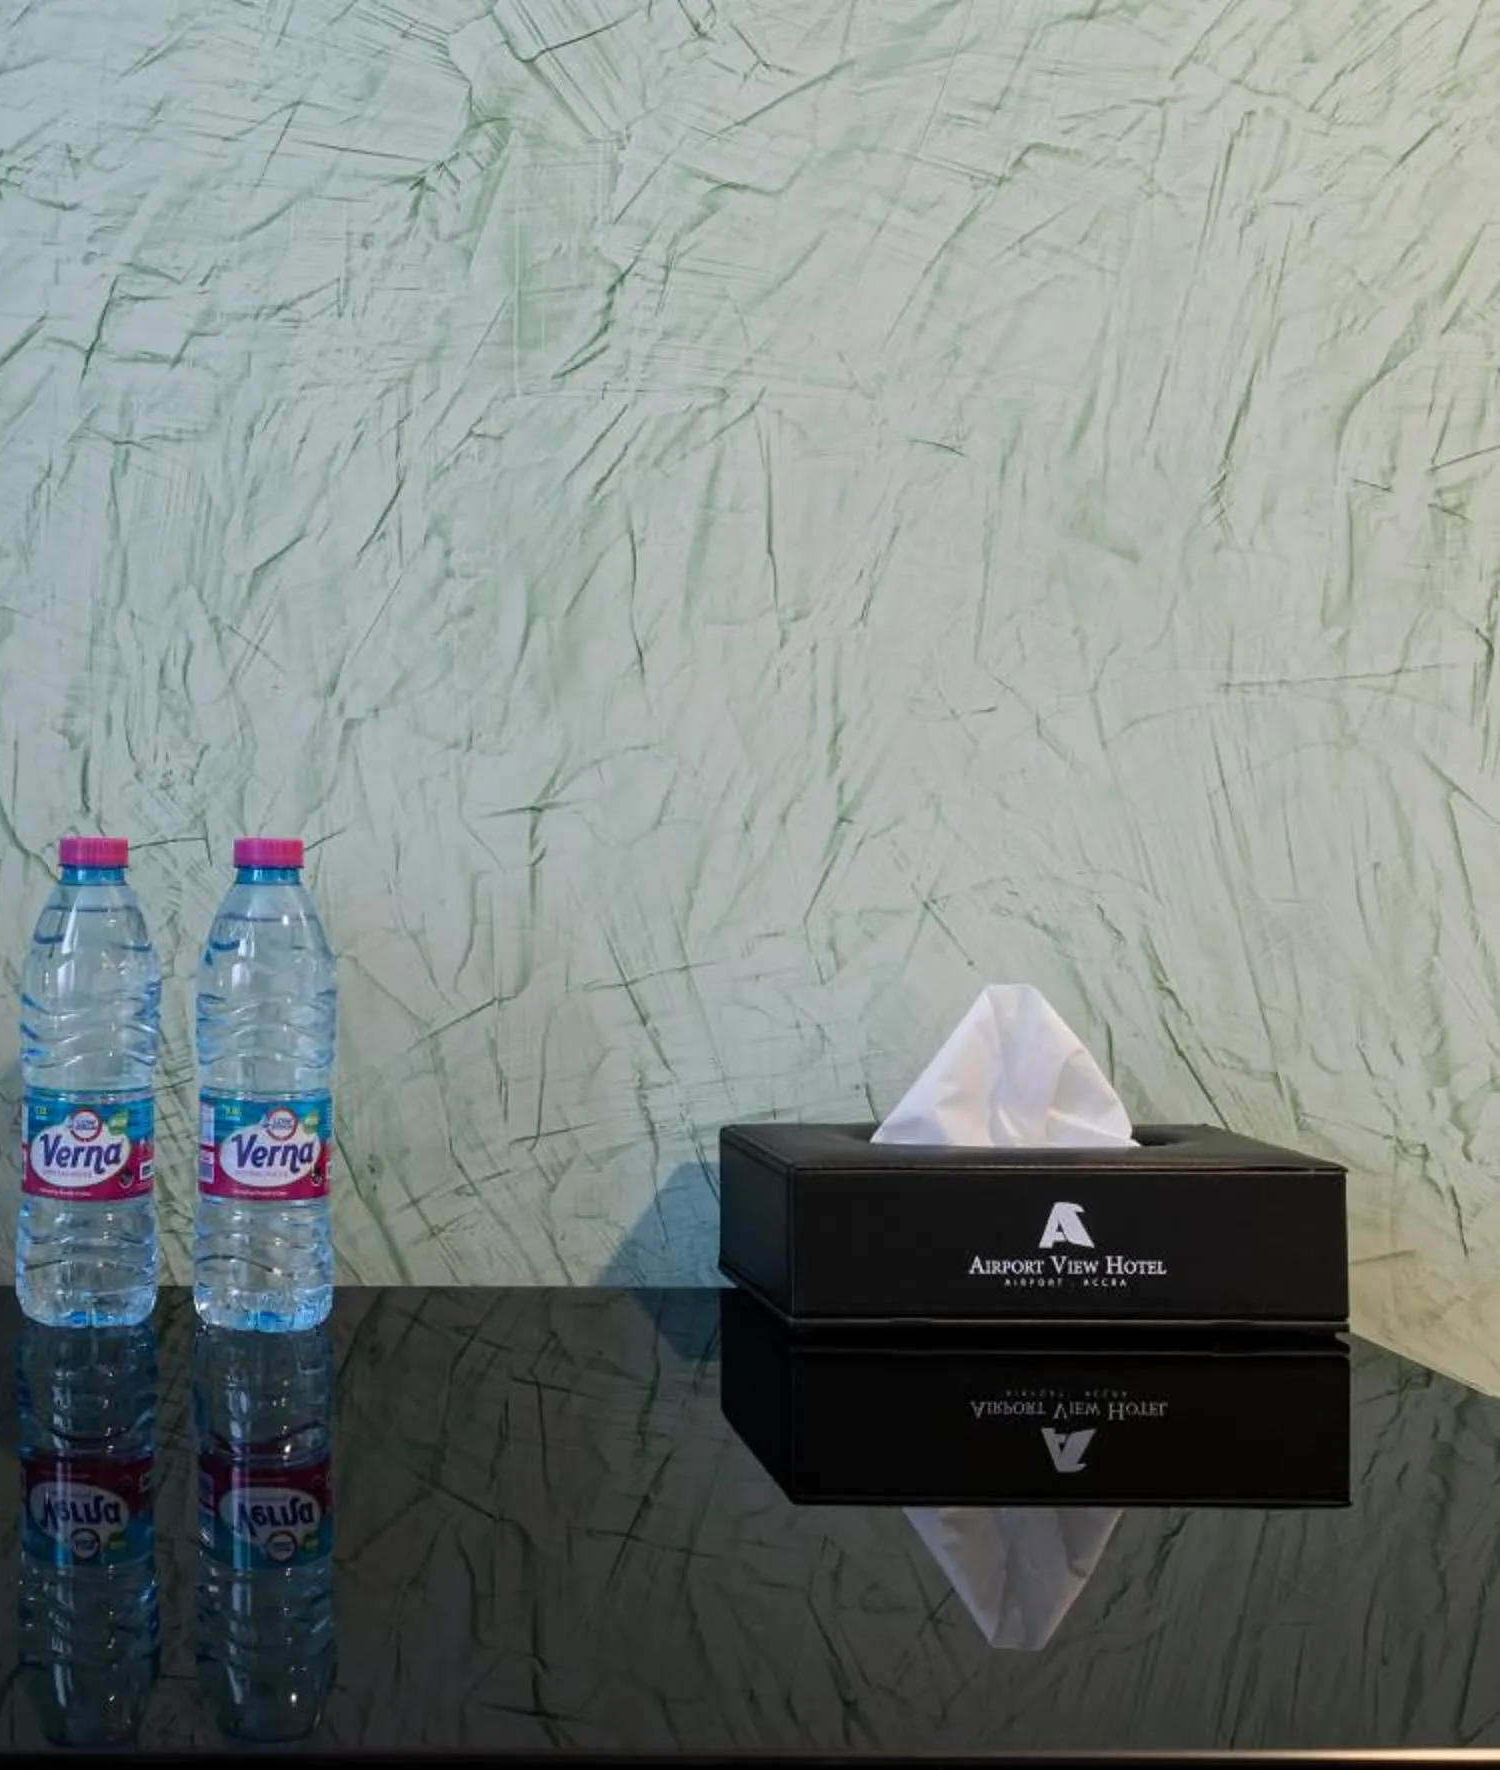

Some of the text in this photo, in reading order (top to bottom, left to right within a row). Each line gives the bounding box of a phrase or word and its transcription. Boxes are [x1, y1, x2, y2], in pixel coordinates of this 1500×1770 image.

[40, 1133, 122, 1175] Verna
[231, 1133, 314, 1174] Verna
[969, 1255, 1167, 1275] AIRPORT VIEW HOTEL
